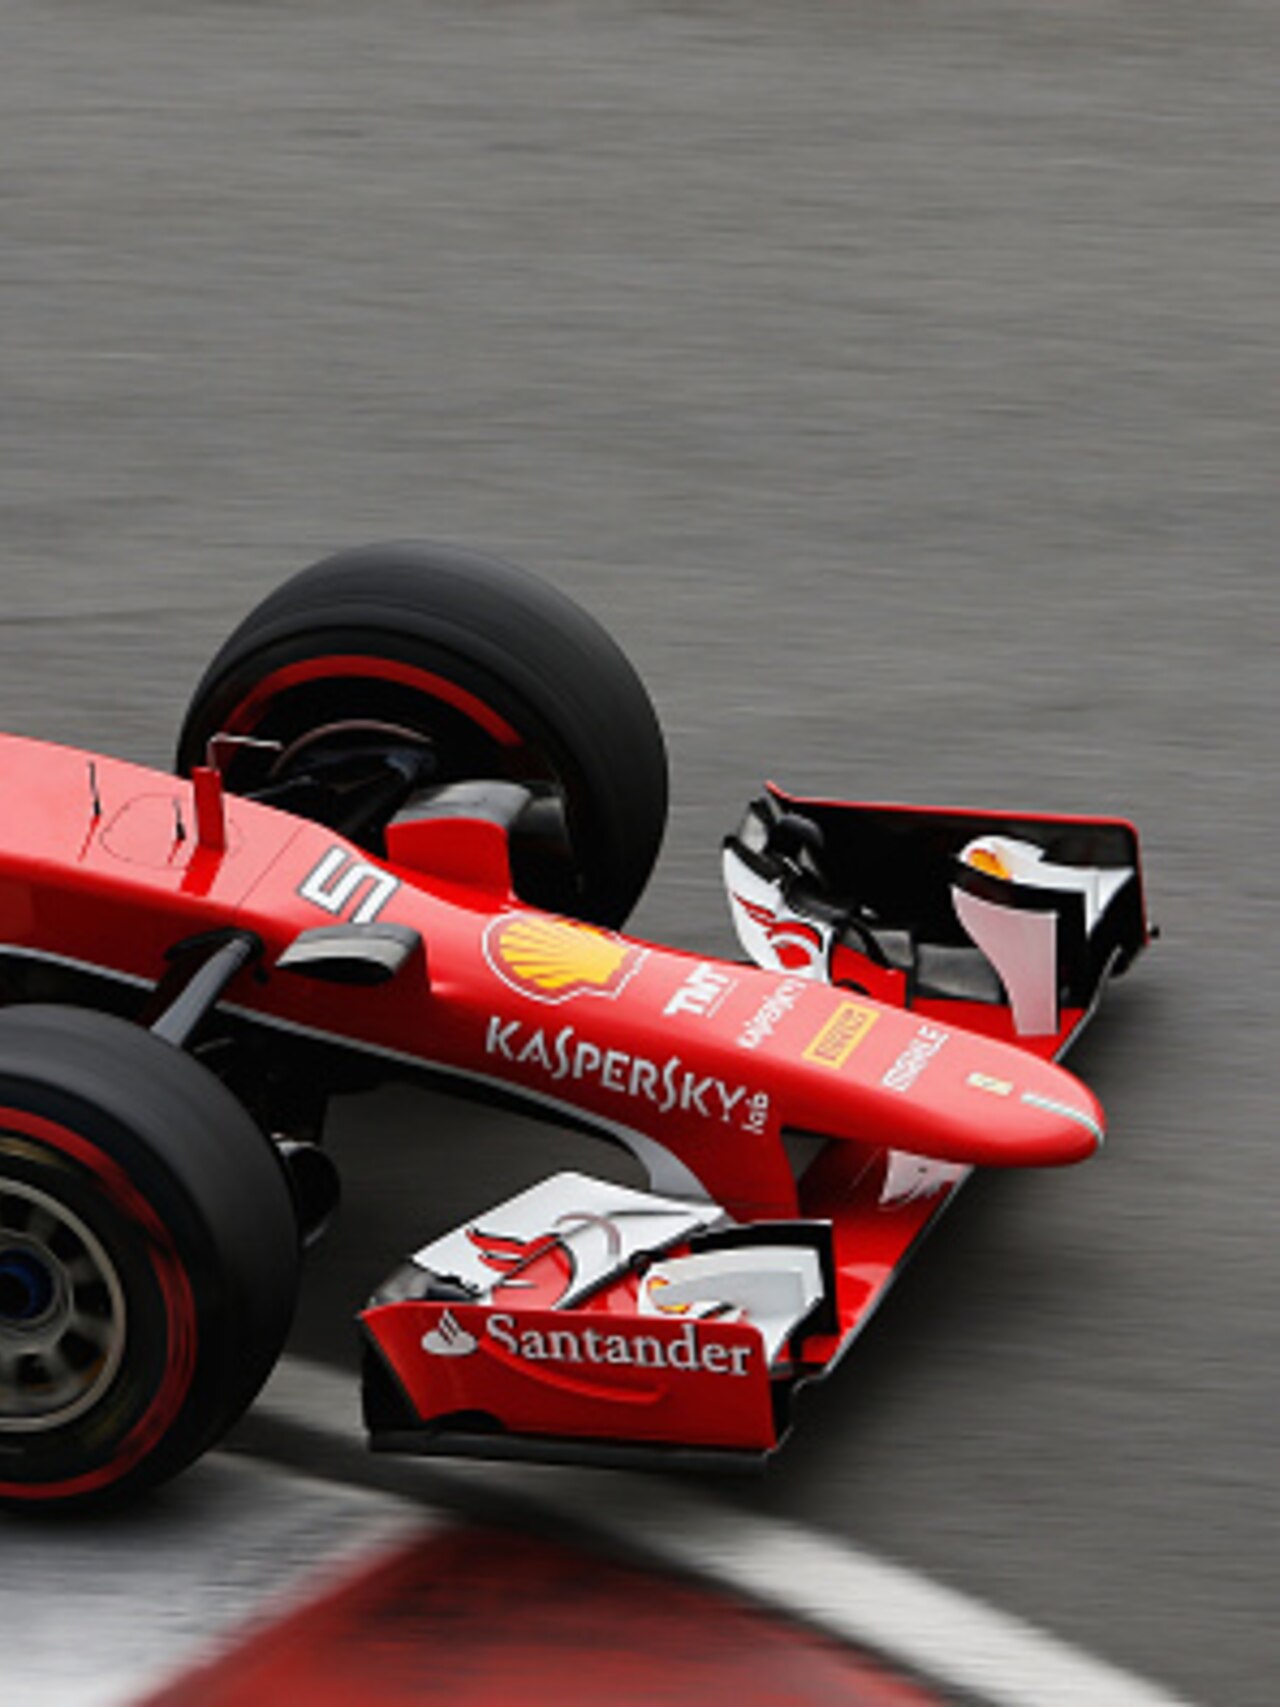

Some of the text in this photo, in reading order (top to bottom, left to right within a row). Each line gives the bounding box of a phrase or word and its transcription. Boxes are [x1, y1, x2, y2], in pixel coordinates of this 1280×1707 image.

[297, 844, 400, 923] 5
[486, 1016, 746, 1121] KASPERSKY
[741, 1093, 767, 1134] lab
[486, 1313, 751, 1375] Santander
